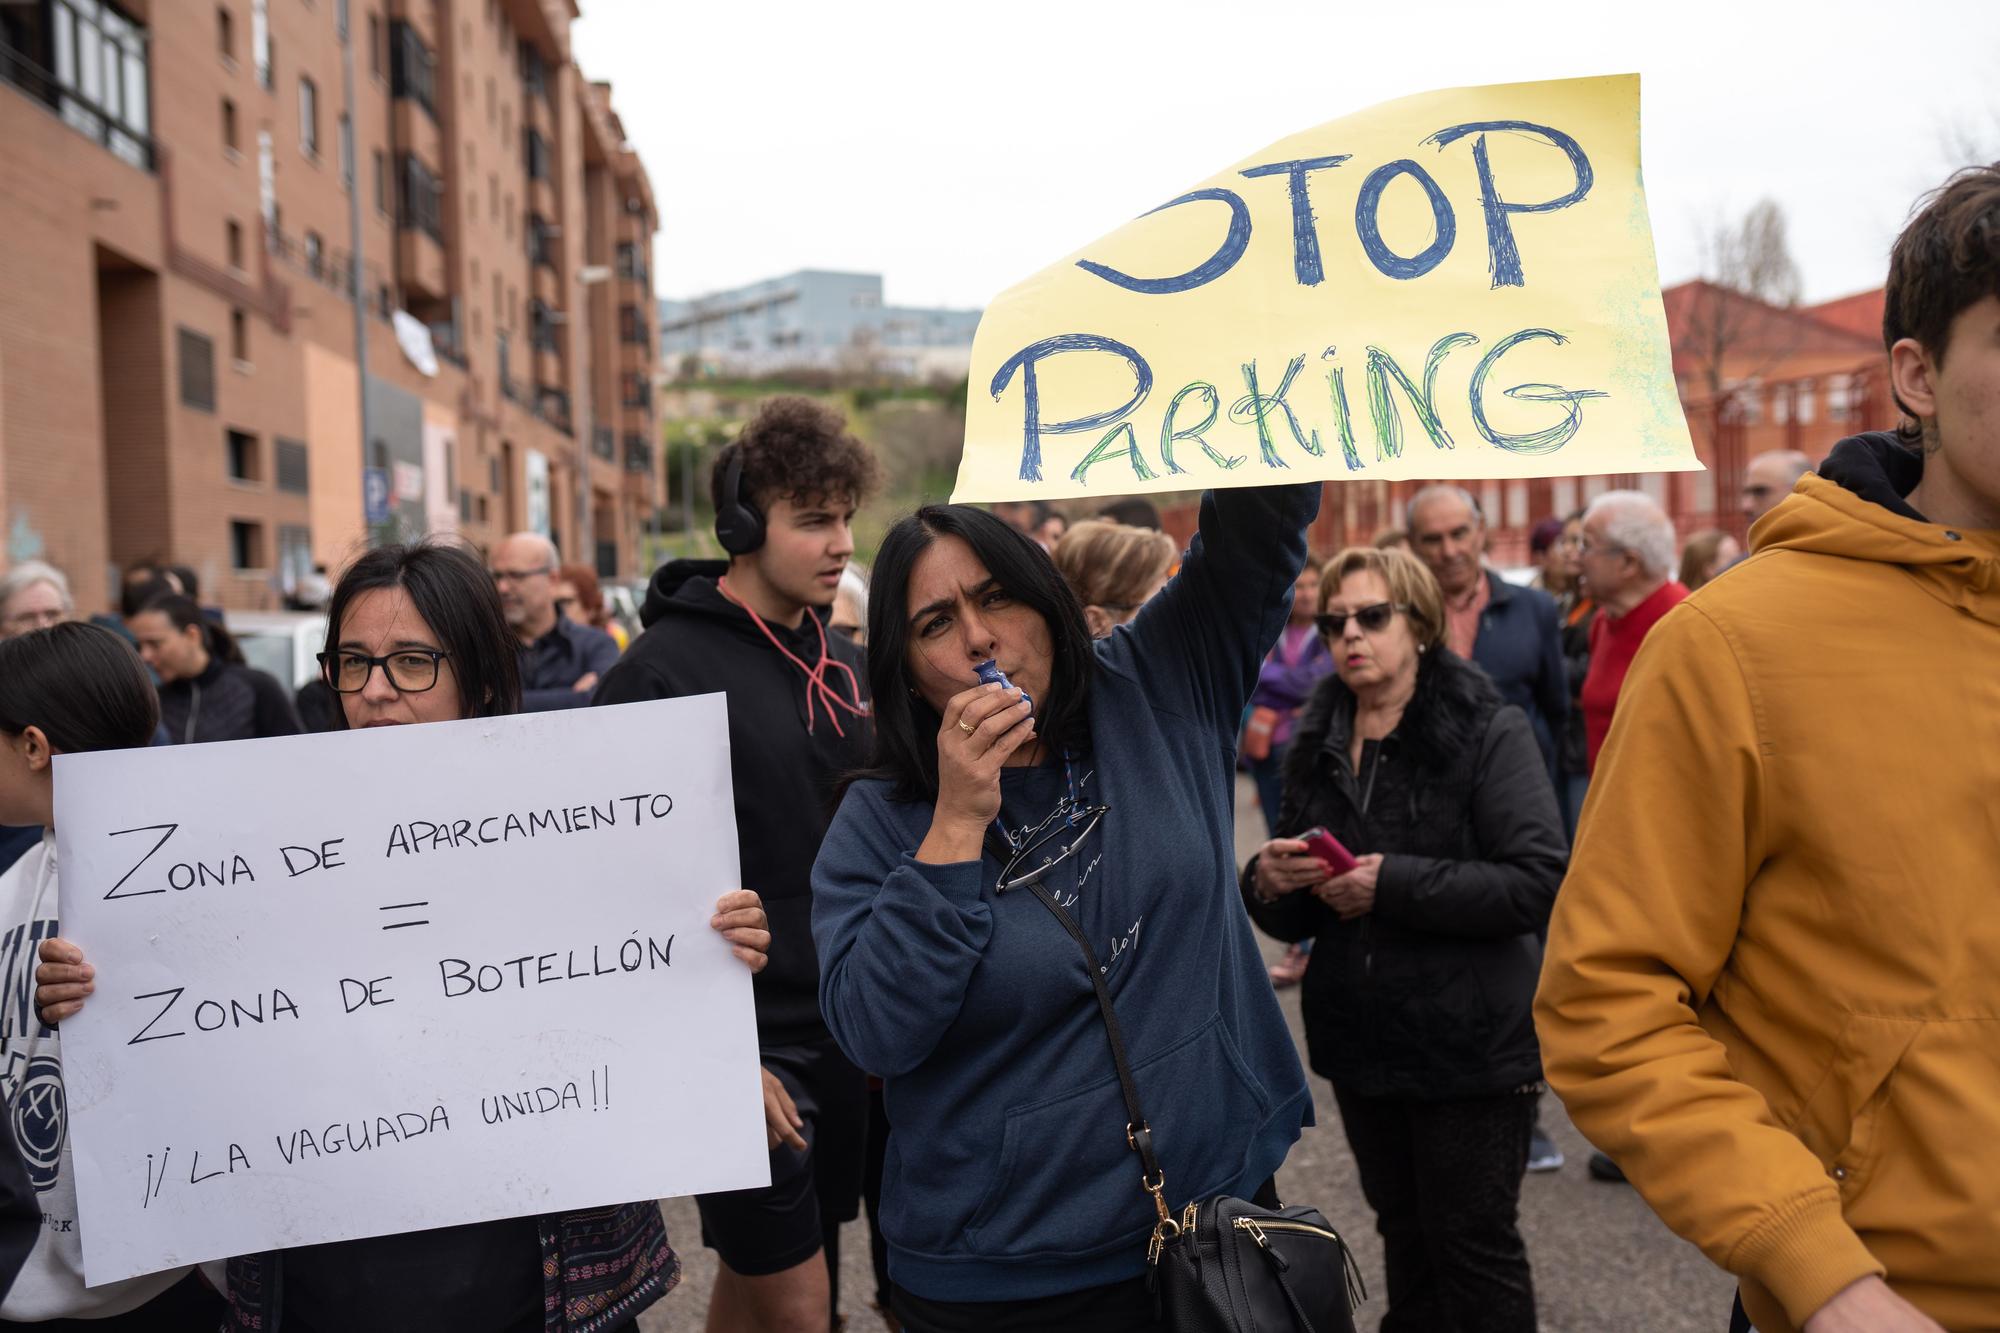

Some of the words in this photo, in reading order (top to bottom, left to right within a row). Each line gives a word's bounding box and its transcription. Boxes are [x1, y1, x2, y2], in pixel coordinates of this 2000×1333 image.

[1074, 119, 1594, 295] STOP
[104, 823, 255, 900] ZONA
[279, 838, 346, 878] DE
[386, 793, 673, 858] APARCAMIENTO
[127, 987, 299, 1046] ZONA
[341, 976, 395, 1014] DE
[439, 929, 675, 998] BOTELLÓN
[276, 1106, 450, 1165] VAGUADA
